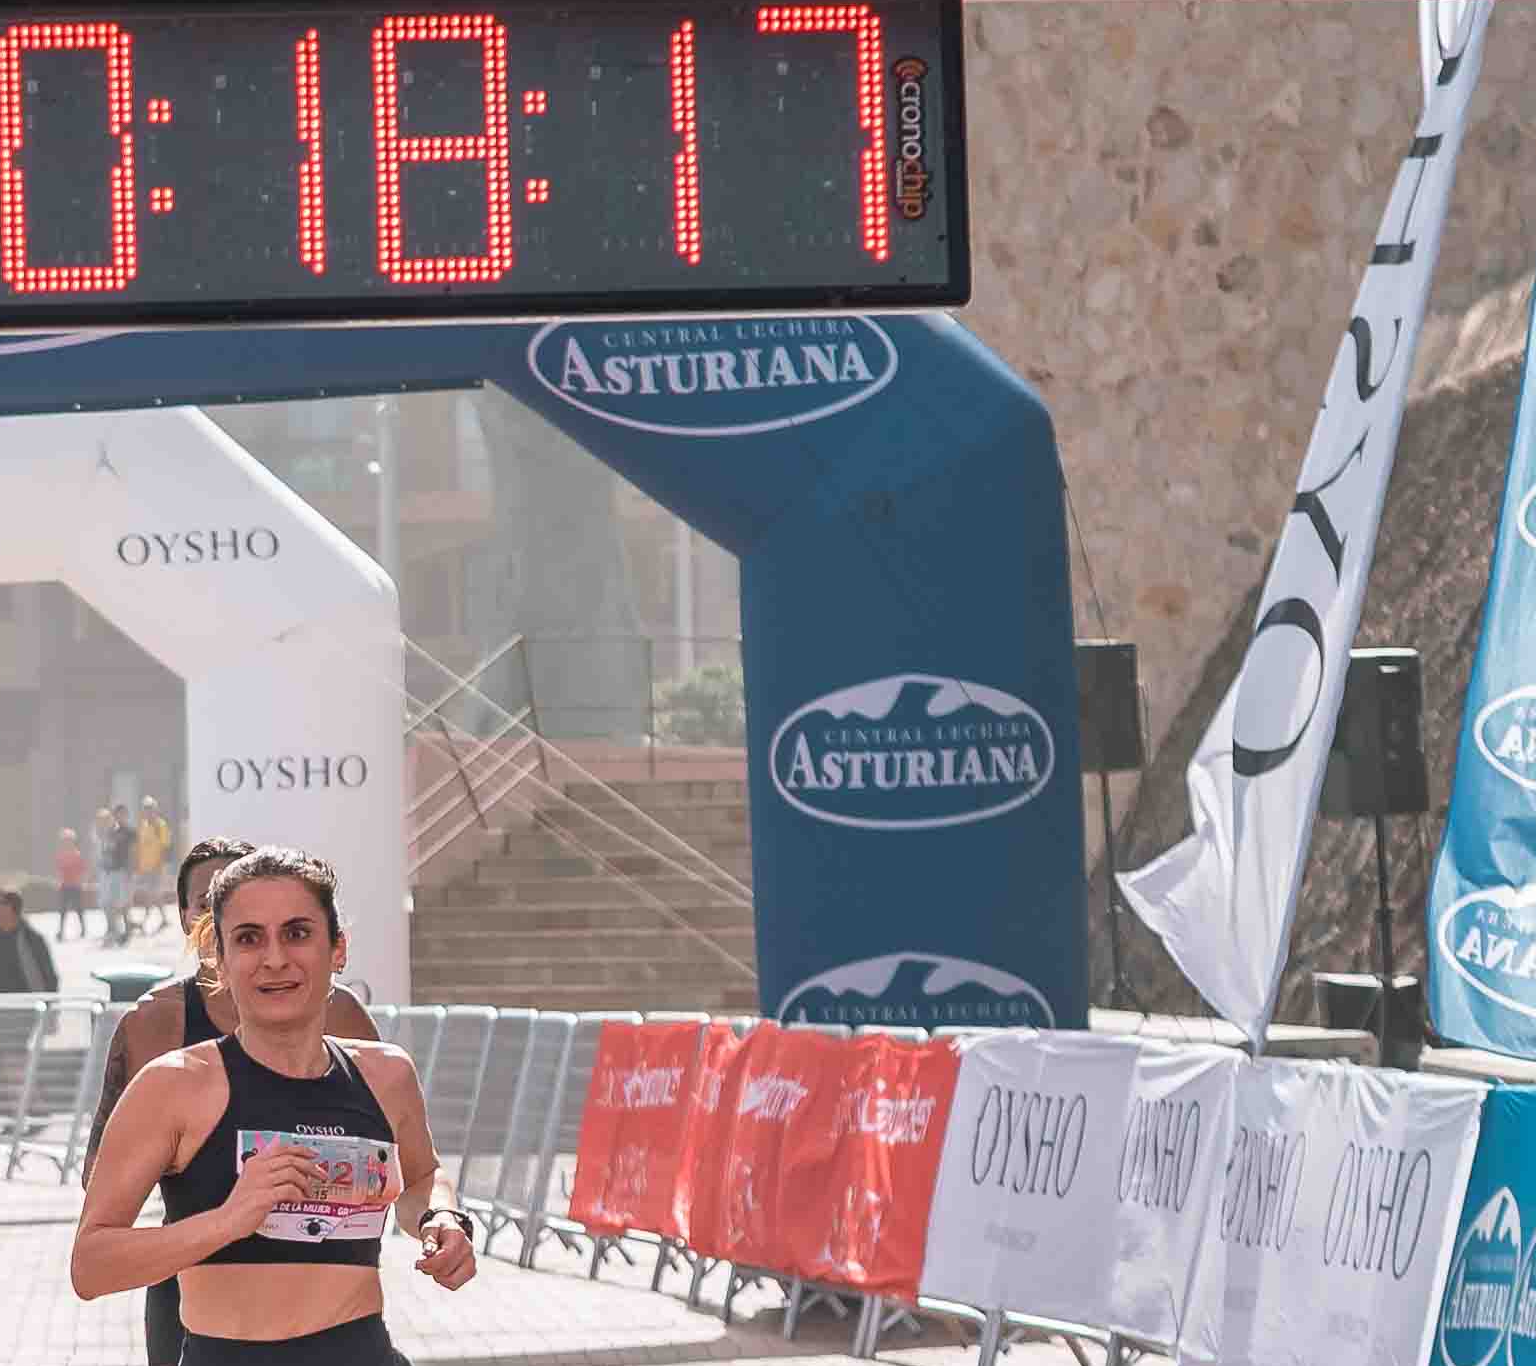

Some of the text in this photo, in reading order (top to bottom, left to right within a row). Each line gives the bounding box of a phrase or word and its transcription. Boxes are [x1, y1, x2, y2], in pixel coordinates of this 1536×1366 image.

[893, 80, 929, 221] cronochip
[560, 335, 874, 397] ASTURIANA
[116, 527, 280, 566] OYSHO
[217, 754, 368, 792] OYSHO
[785, 729, 1038, 792] ASTURIANA
[295, 1123, 346, 1136] OYSHO
[970, 1085, 1089, 1199] OYSHO
[1322, 1139, 1432, 1280] OYSHO
